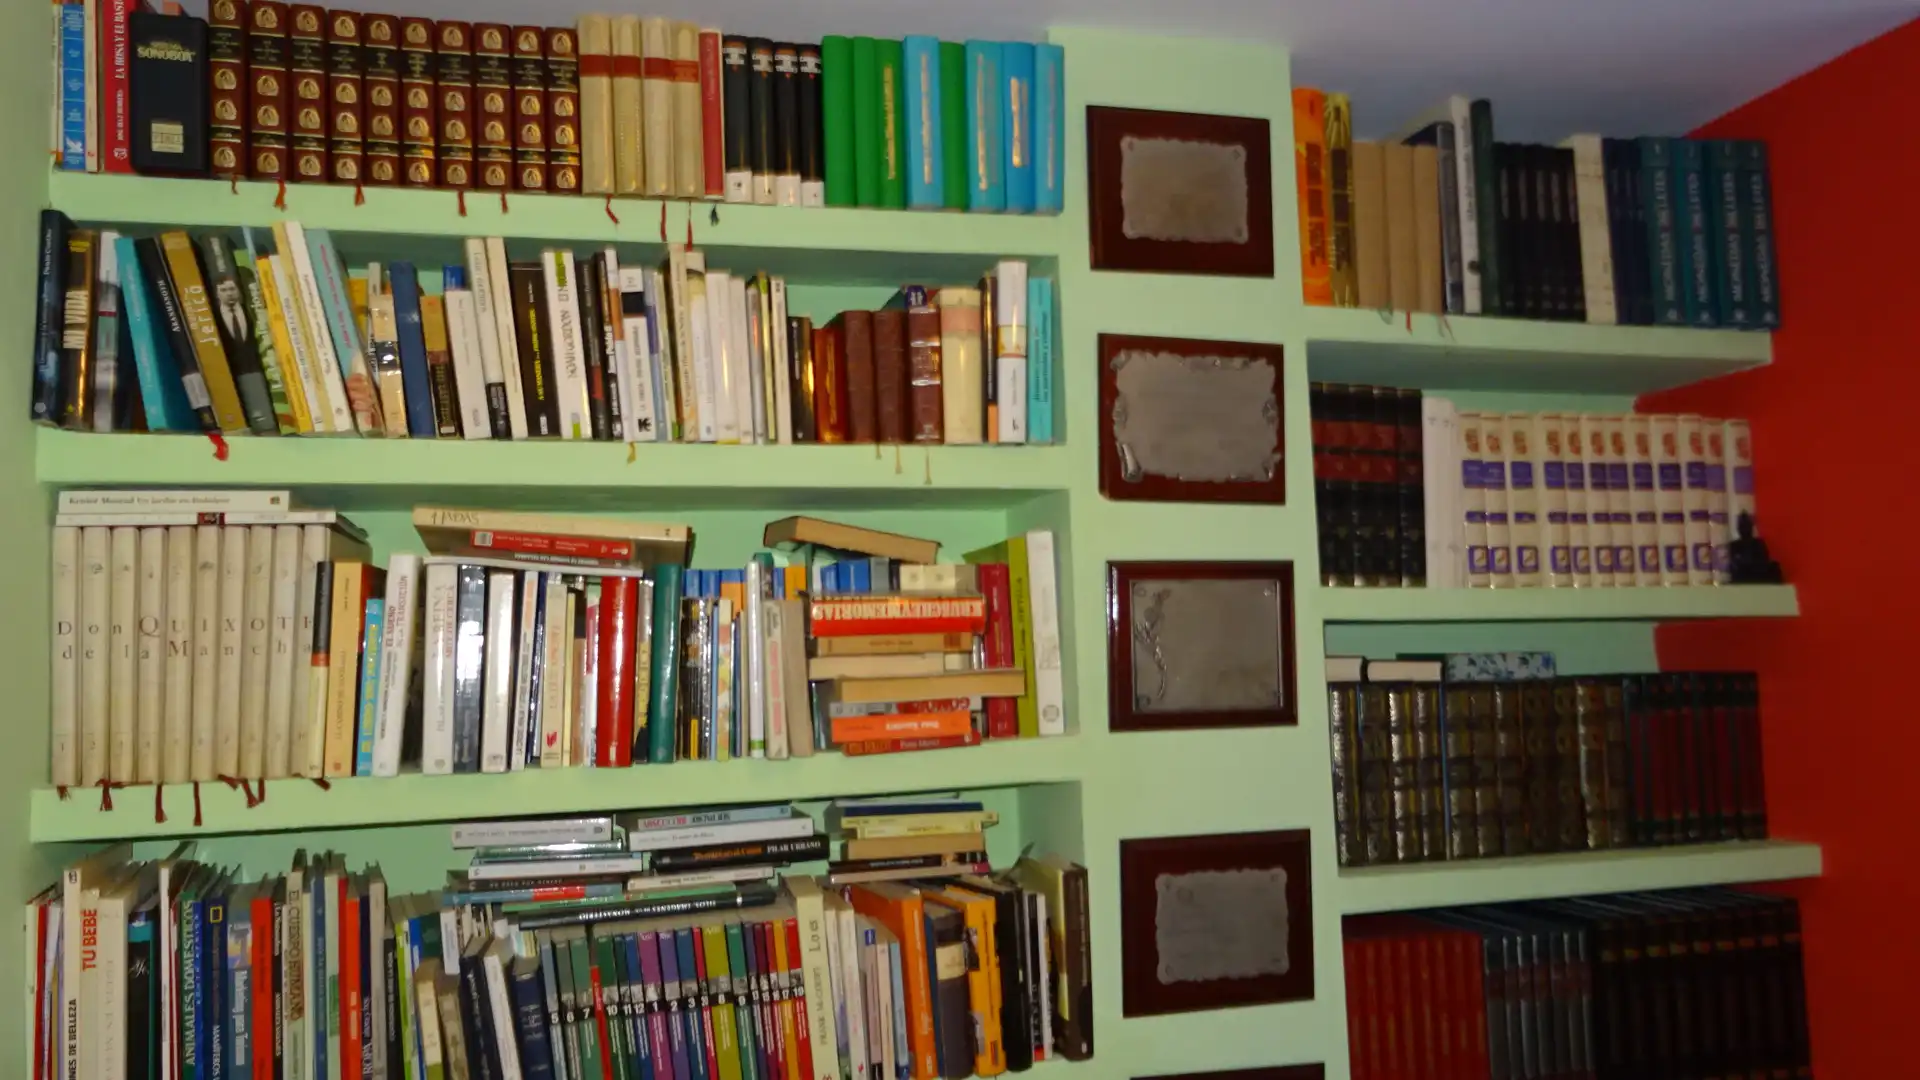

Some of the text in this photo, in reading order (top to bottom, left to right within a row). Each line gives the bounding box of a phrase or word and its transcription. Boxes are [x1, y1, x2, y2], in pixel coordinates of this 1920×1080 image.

[63, 290, 88, 348] MI VIDA
[80, 910, 97, 972] TU BEBÉ
[288, 890, 304, 1022] EL CUERPO HUMANO
[804, 920, 820, 952] Lo es
[68, 998, 78, 1041] BELLEZA
[184, 994, 196, 1066] ANIMALES
[670, 1000, 678, 1010] 2
